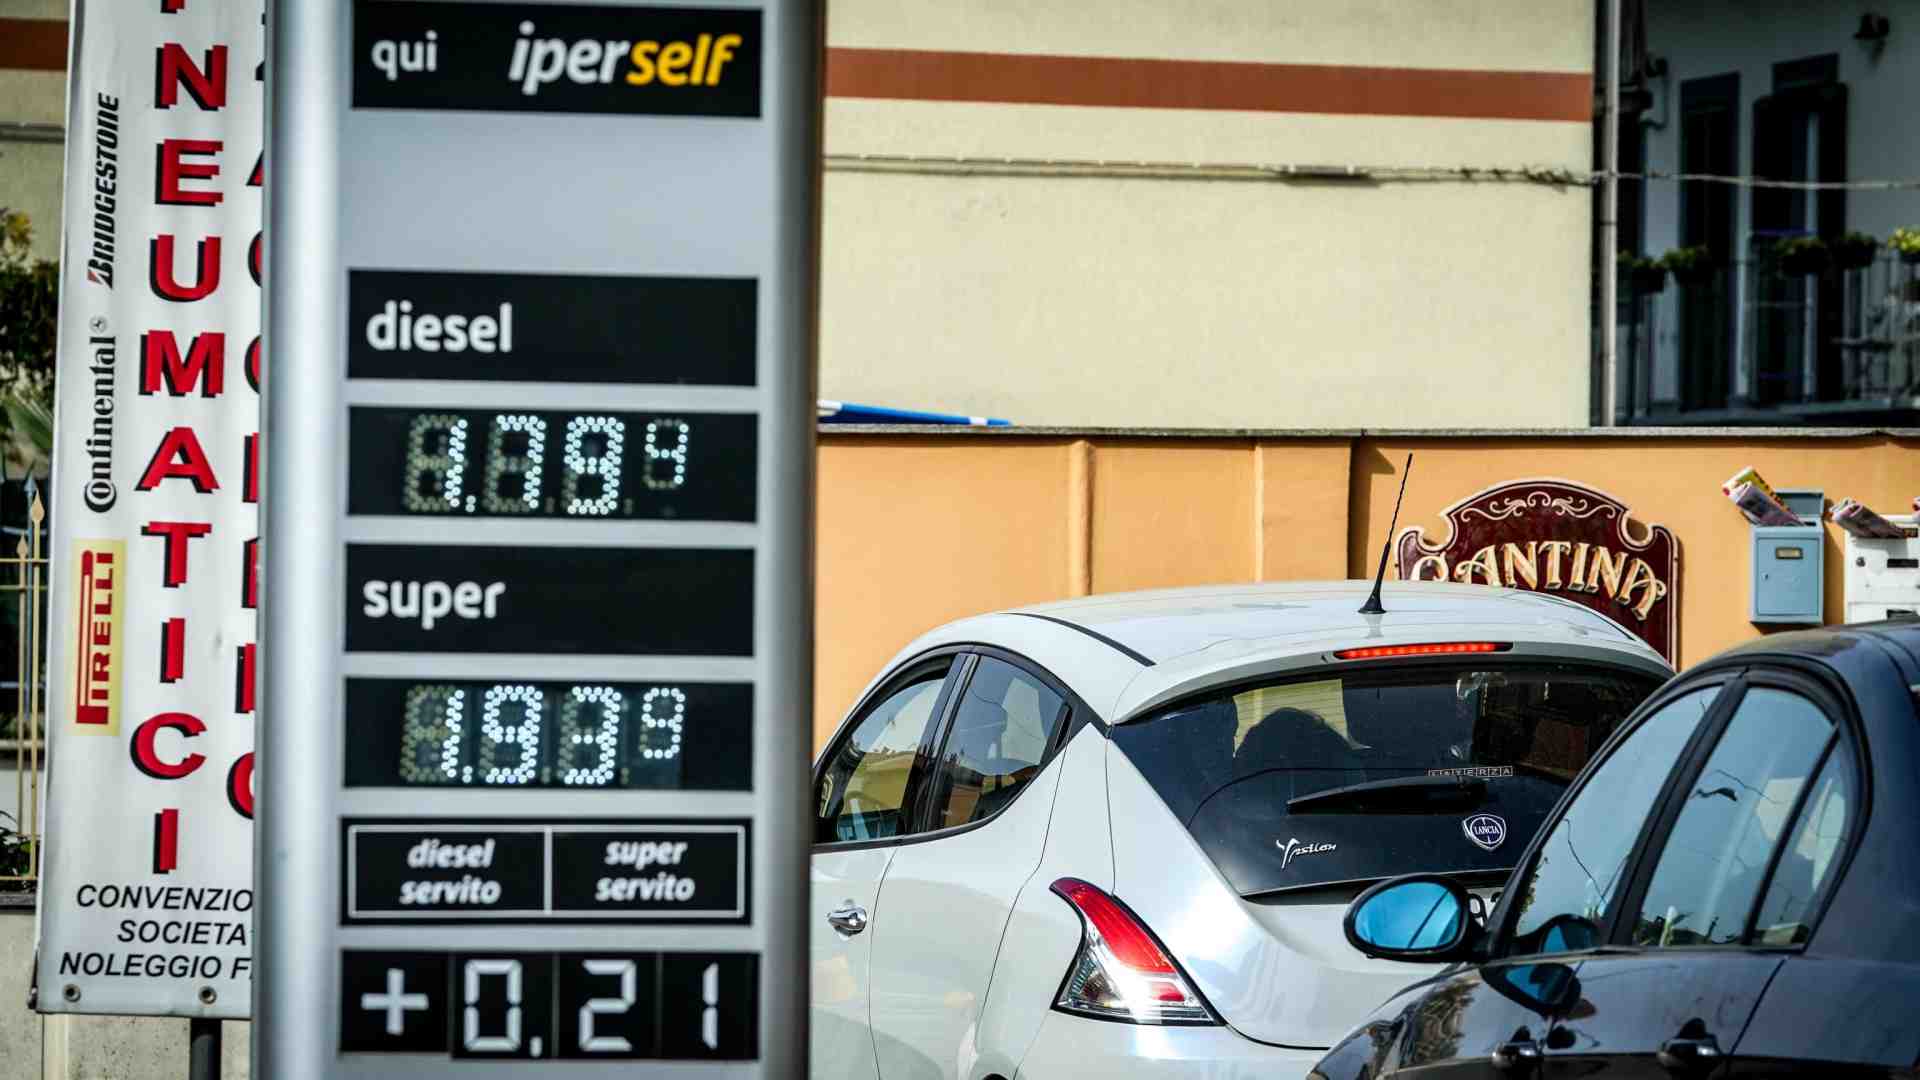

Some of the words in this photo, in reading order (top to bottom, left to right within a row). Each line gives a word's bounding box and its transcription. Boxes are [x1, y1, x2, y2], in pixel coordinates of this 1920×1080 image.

[371, 30, 439, 81] qui
[508, 20, 742, 95] iperself
[87, 92, 119, 290] BRIDGESTONE
[366, 300, 513, 353] diesel
[83, 336, 117, 513] Continental
[130, 0, 229, 874] NEUMATICI
[363, 580, 507, 630] super
[76, 550, 114, 724] PIRELLI
[1474, 825, 1500, 836] LANCIA
[407, 838, 496, 868] diesel
[605, 841, 688, 870] super
[1275, 837, 1337, 869] Ypsilon
[76, 884, 253, 912] CONVENZIO
[399, 874, 501, 905] servito
[595, 871, 695, 902] servito
[117, 919, 247, 946] SOCIETA
[59, 951, 222, 979] NOLEGGIO
